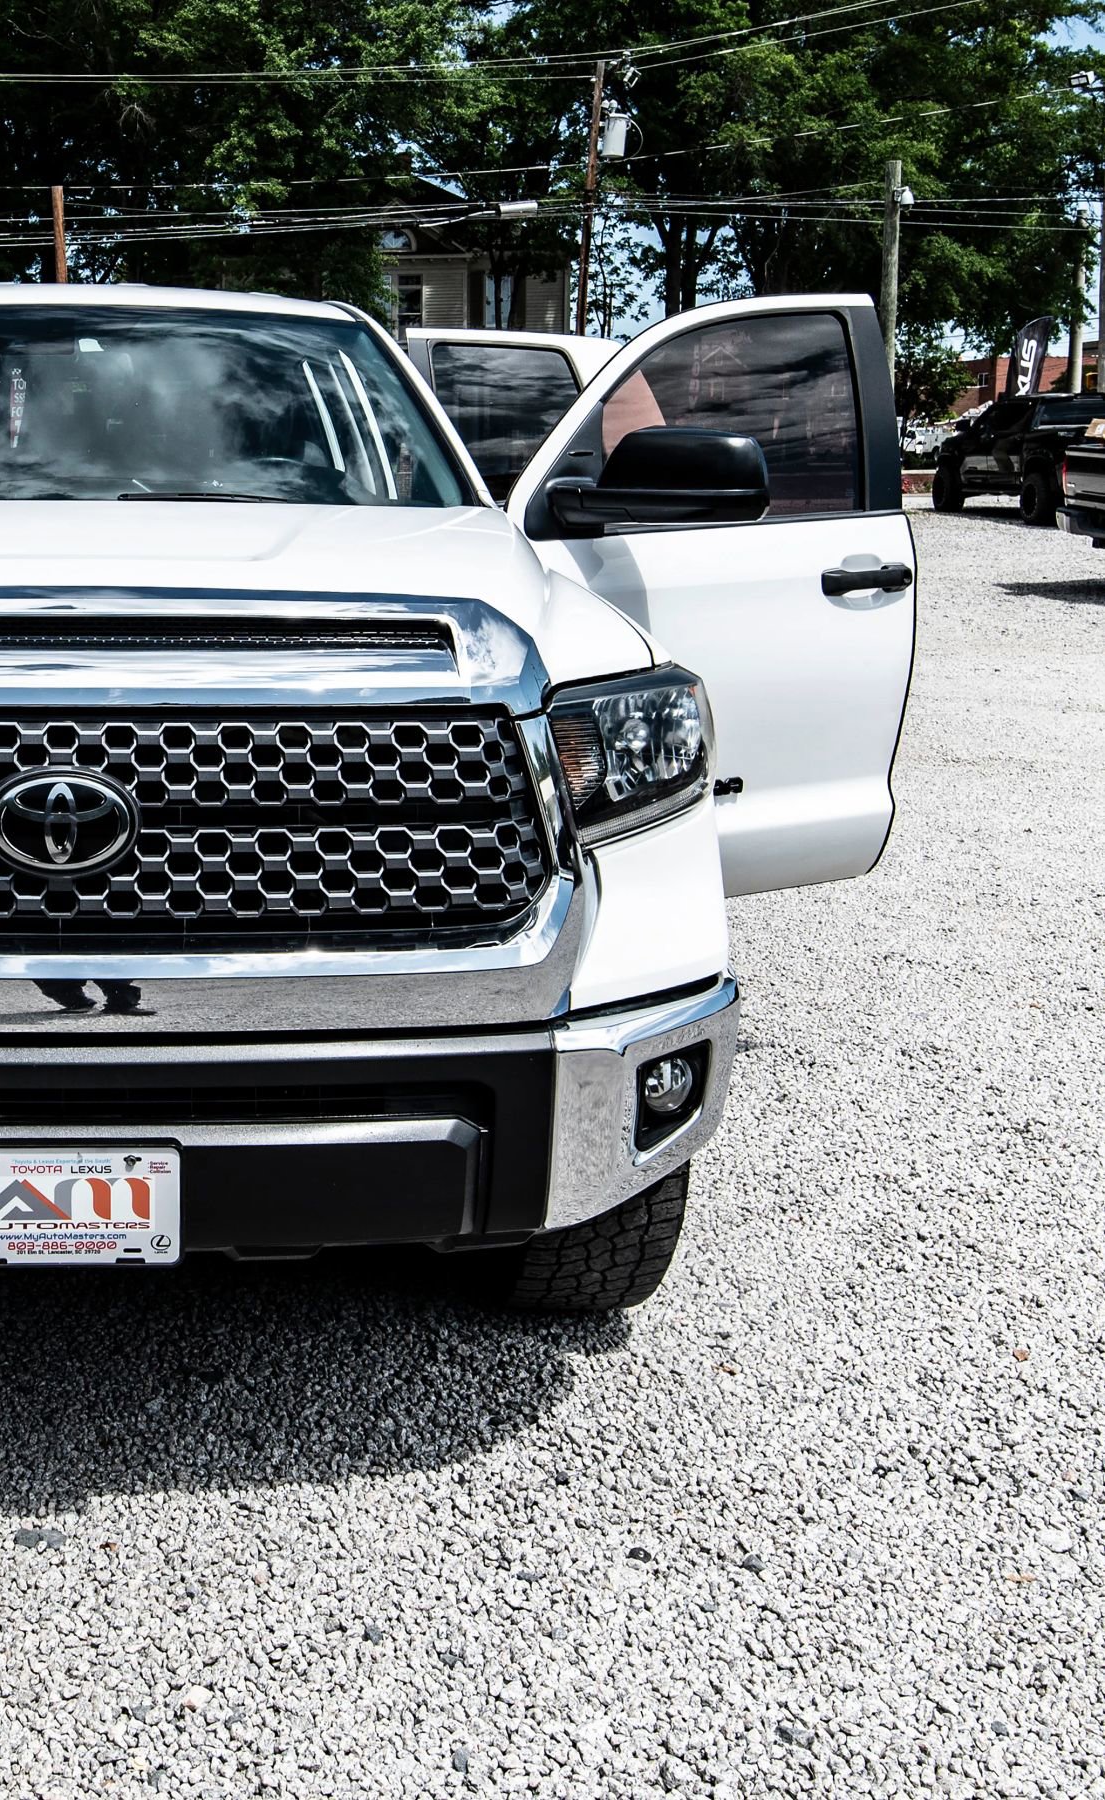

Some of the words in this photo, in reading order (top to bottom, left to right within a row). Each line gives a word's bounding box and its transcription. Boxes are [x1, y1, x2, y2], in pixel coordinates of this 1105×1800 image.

[10, 1165, 63, 1174] TOYOTA
[70, 1165, 112, 1174] LEXUS
[7, 1241, 117, 1250] 803-886-0000
